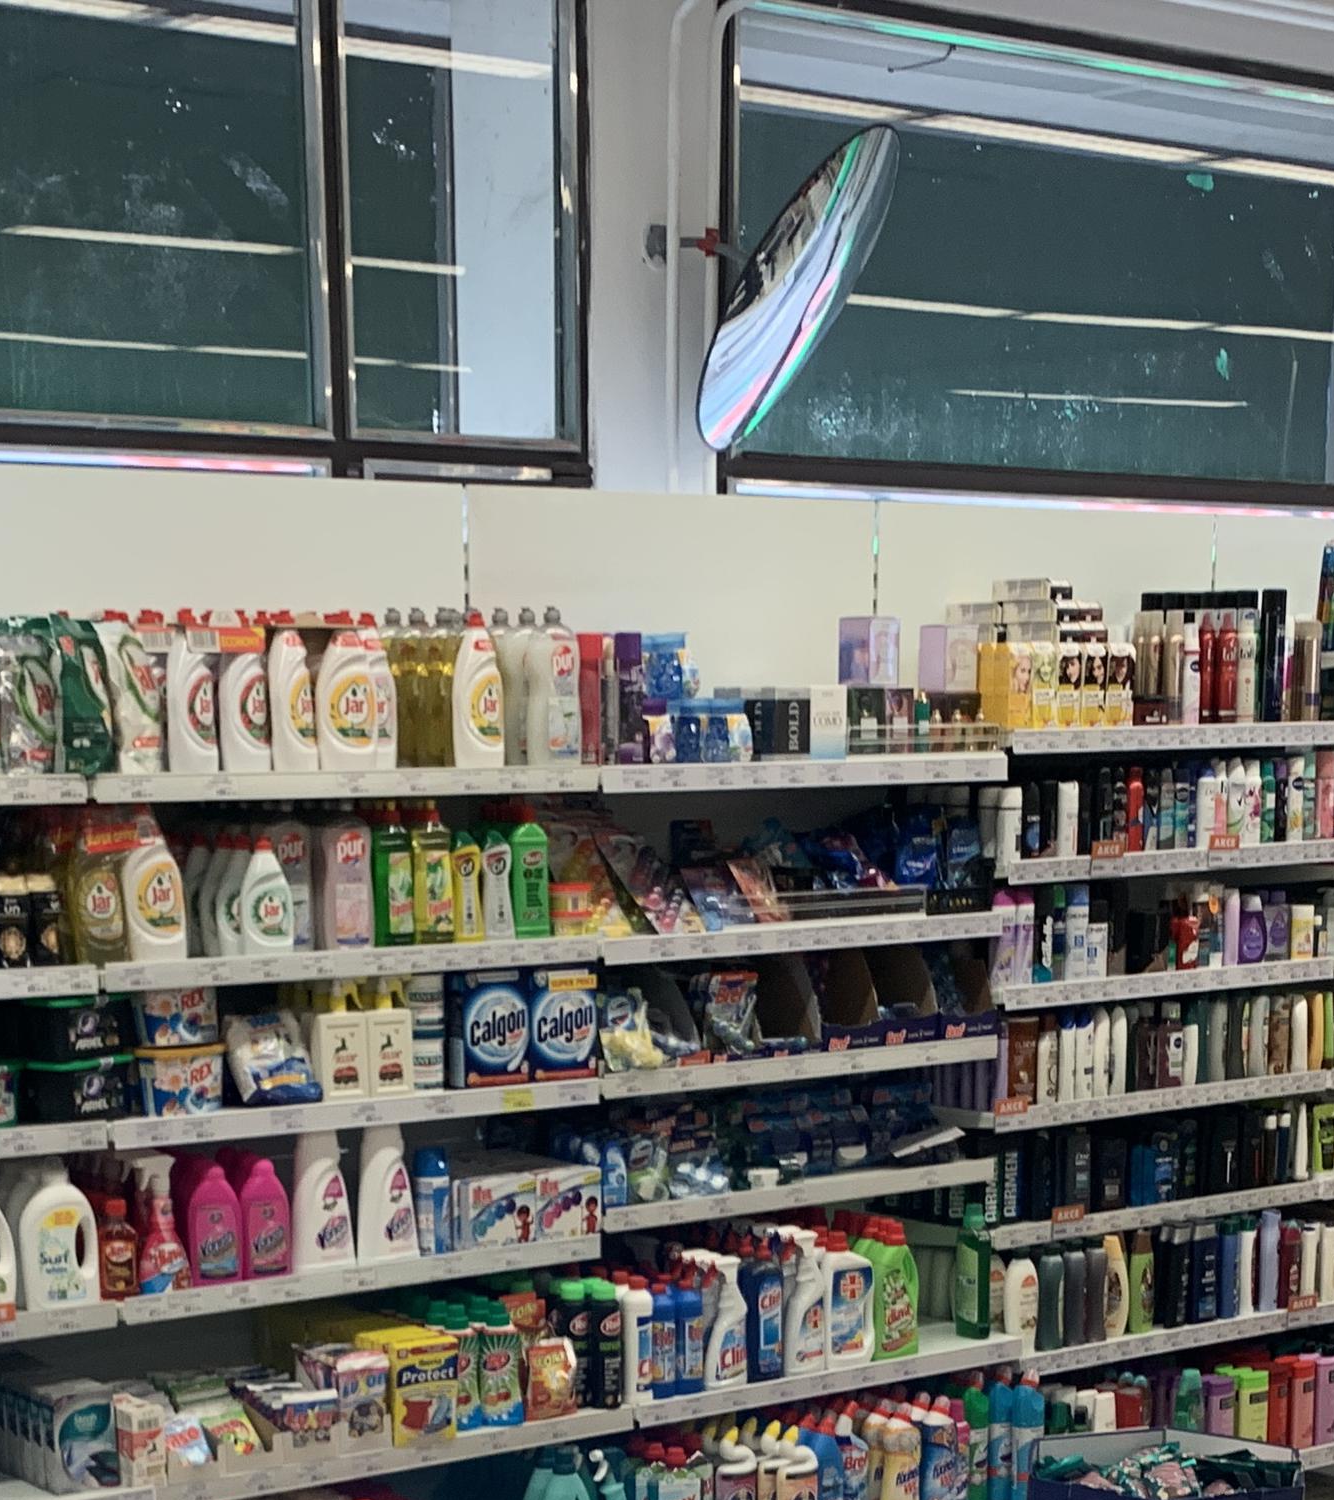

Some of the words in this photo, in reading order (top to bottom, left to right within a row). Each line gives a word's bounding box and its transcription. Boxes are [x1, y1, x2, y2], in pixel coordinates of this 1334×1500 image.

[789, 702, 800, 751] BOLD
[1097, 844, 1121, 856] AKCE
[1214, 838, 1237, 848] AKCE
[469, 1009, 525, 1047] Calgon
[536, 1002, 593, 1044] Calgon
[190, 1061, 213, 1083] REX
[402, 1368, 455, 1385] Protect
